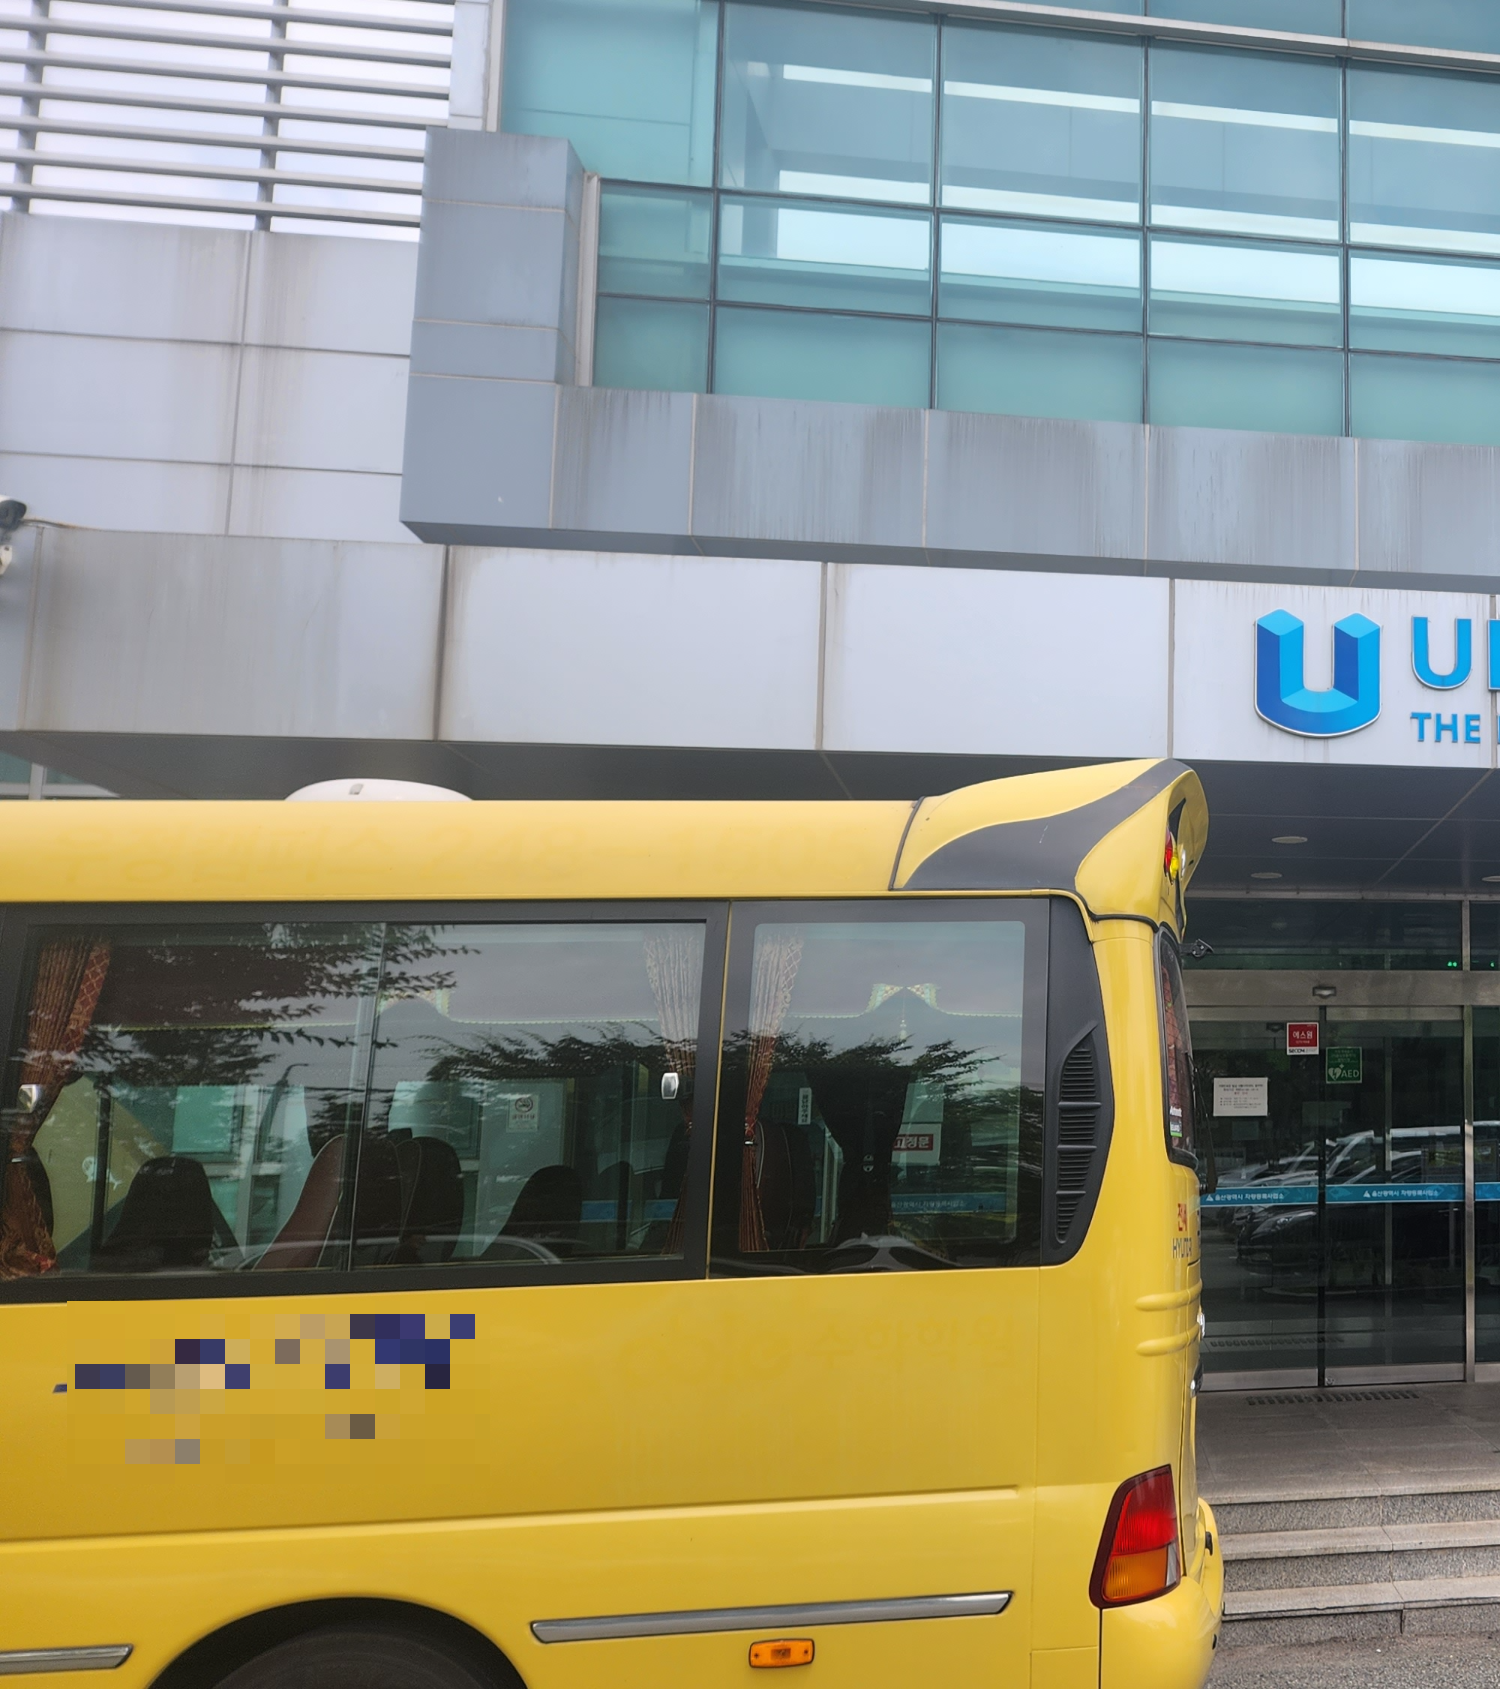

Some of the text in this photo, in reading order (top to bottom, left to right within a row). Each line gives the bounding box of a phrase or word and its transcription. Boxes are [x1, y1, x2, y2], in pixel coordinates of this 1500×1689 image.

[1410, 711, 1481, 743] THE
[1292, 1030, 1313, 1040] 에스원
[1341, 1069, 1360, 1078] AED
